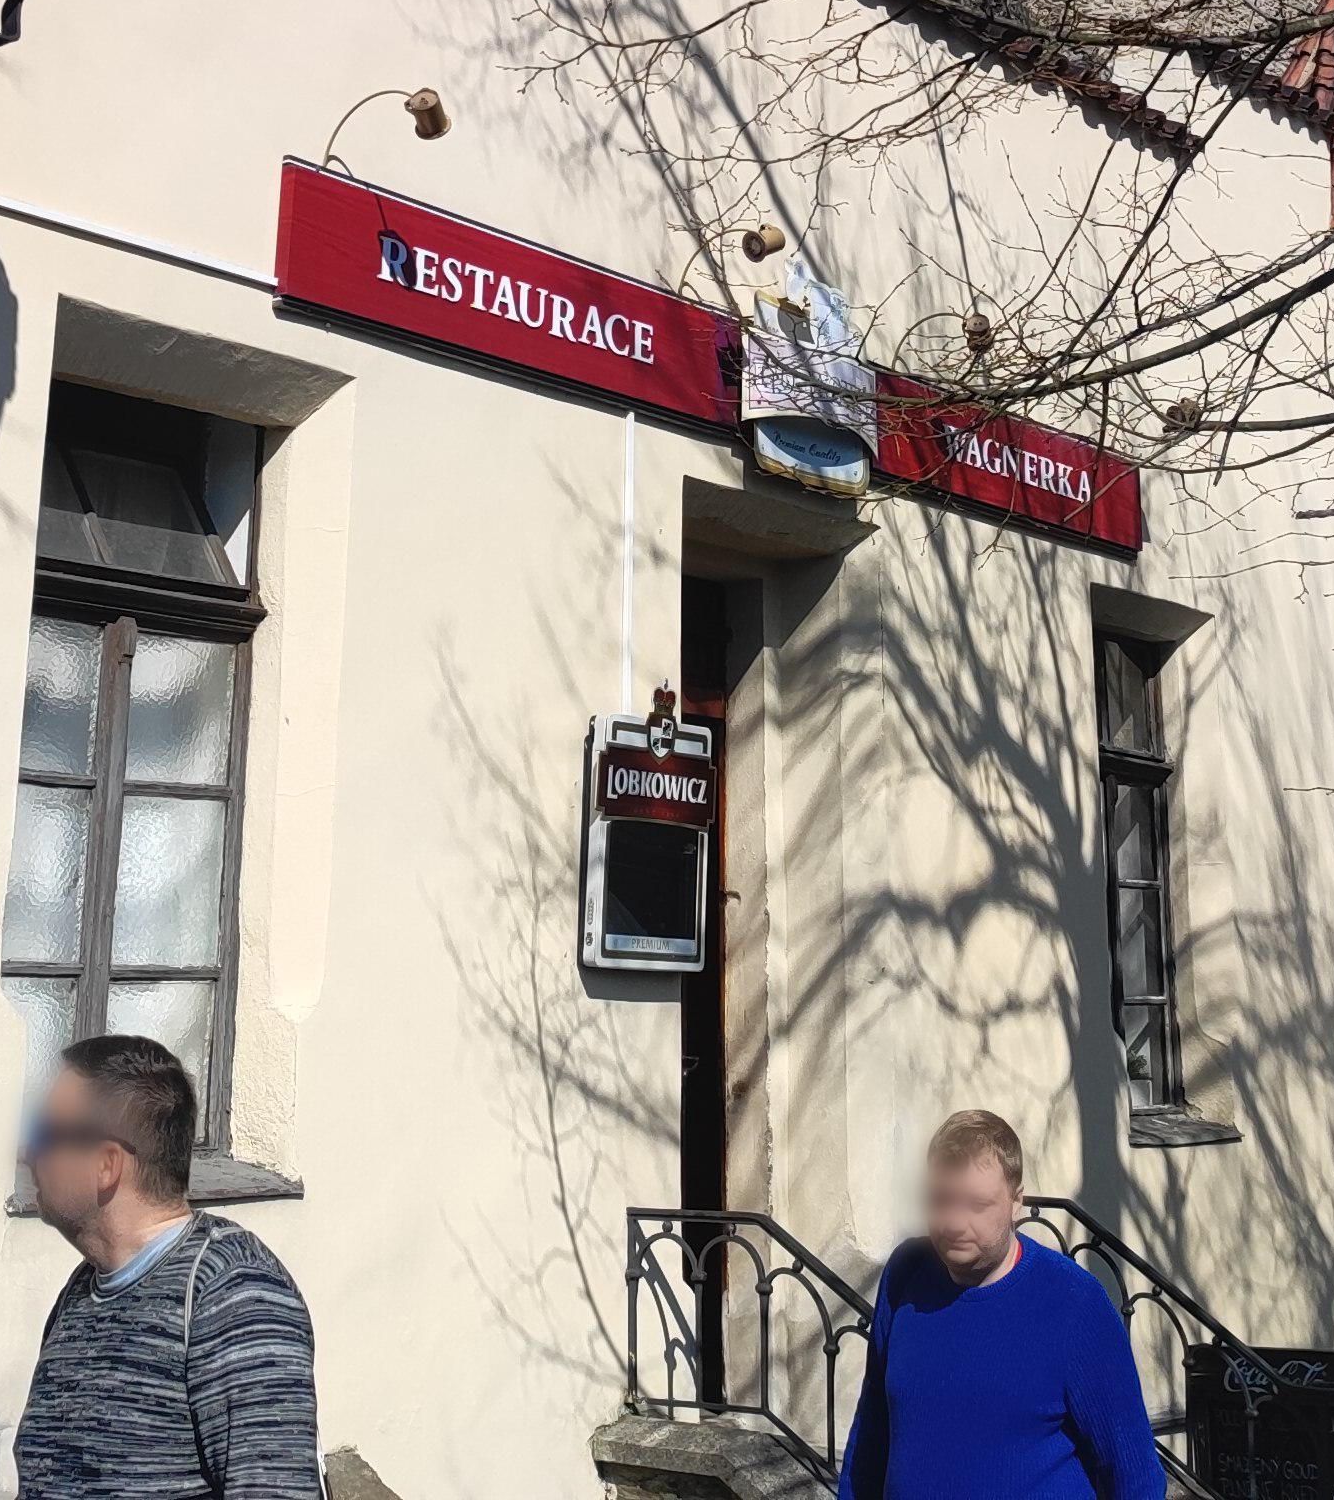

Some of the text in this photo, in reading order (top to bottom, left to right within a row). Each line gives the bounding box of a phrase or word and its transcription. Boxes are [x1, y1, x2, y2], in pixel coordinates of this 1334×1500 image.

[377, 233, 655, 365] RESTAURACE
[772, 430, 806, 454] Premium
[943, 424, 1092, 506] WAGNERKA
[606, 764, 708, 805] LOBKOWICZ
[631, 937, 670, 951] PREMIUM
